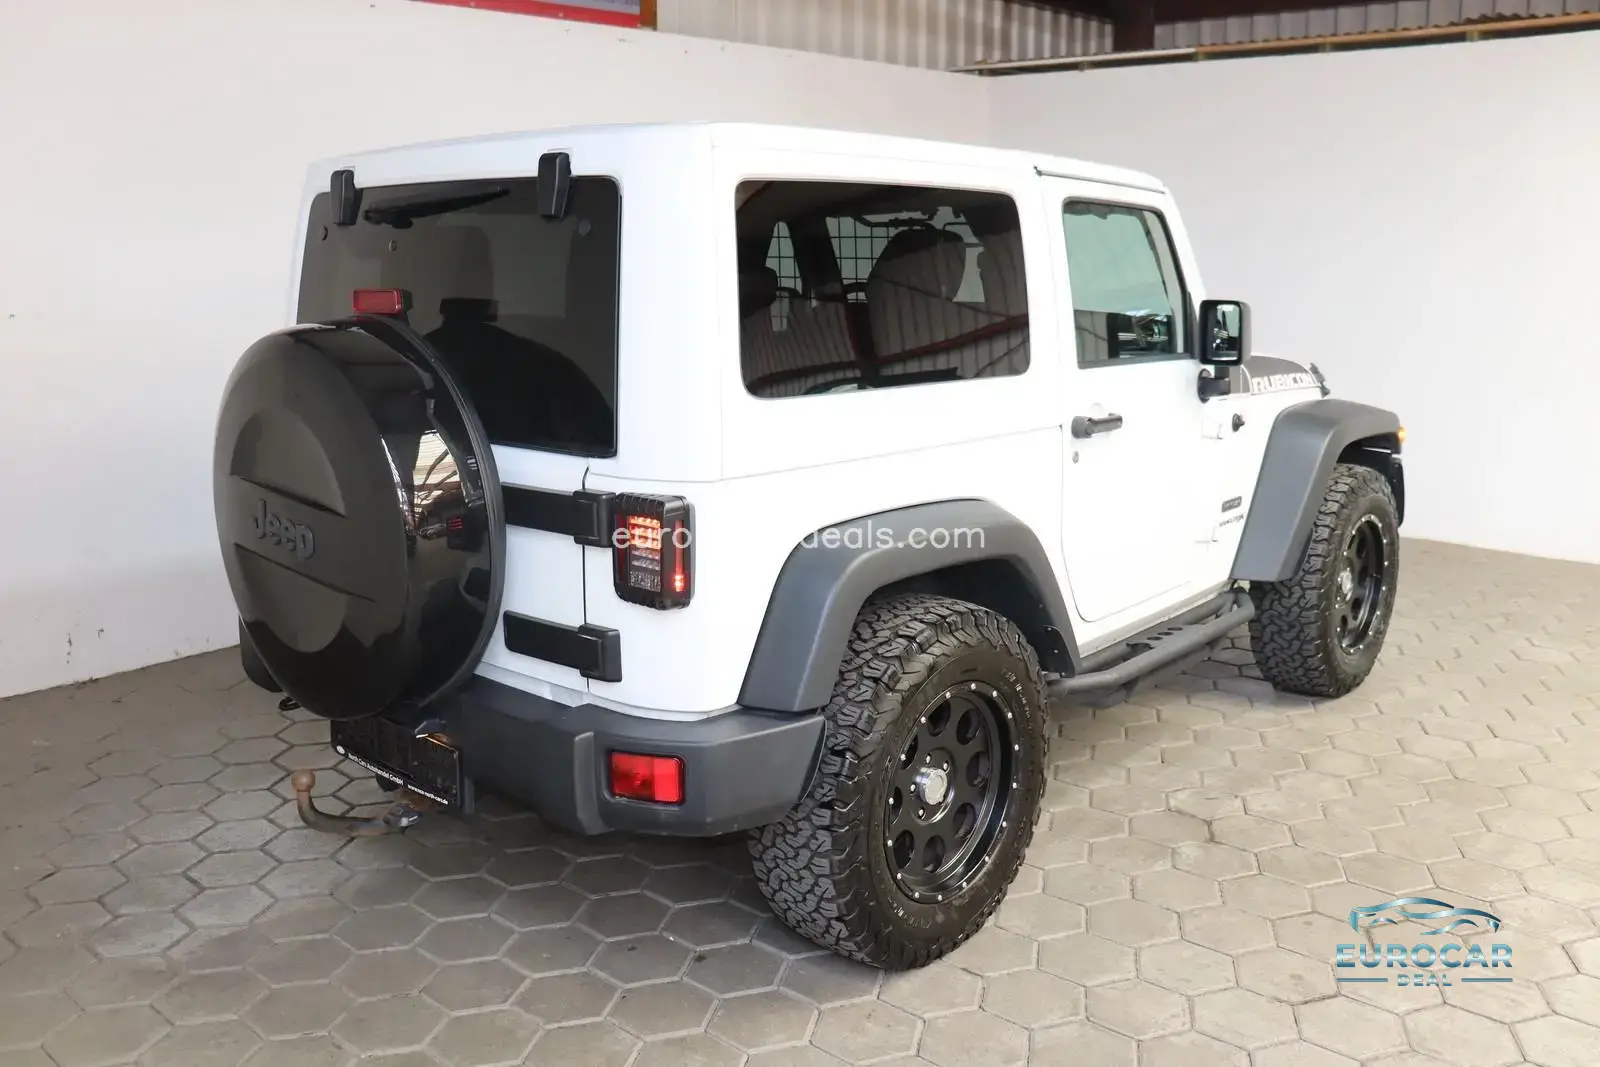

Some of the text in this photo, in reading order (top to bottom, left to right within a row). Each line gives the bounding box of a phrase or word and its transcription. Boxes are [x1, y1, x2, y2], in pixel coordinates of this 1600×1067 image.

[1252, 372, 1314, 393] RUBICON
[251, 498, 316, 563] Jeep
[389, 774, 404, 786] GmbH
